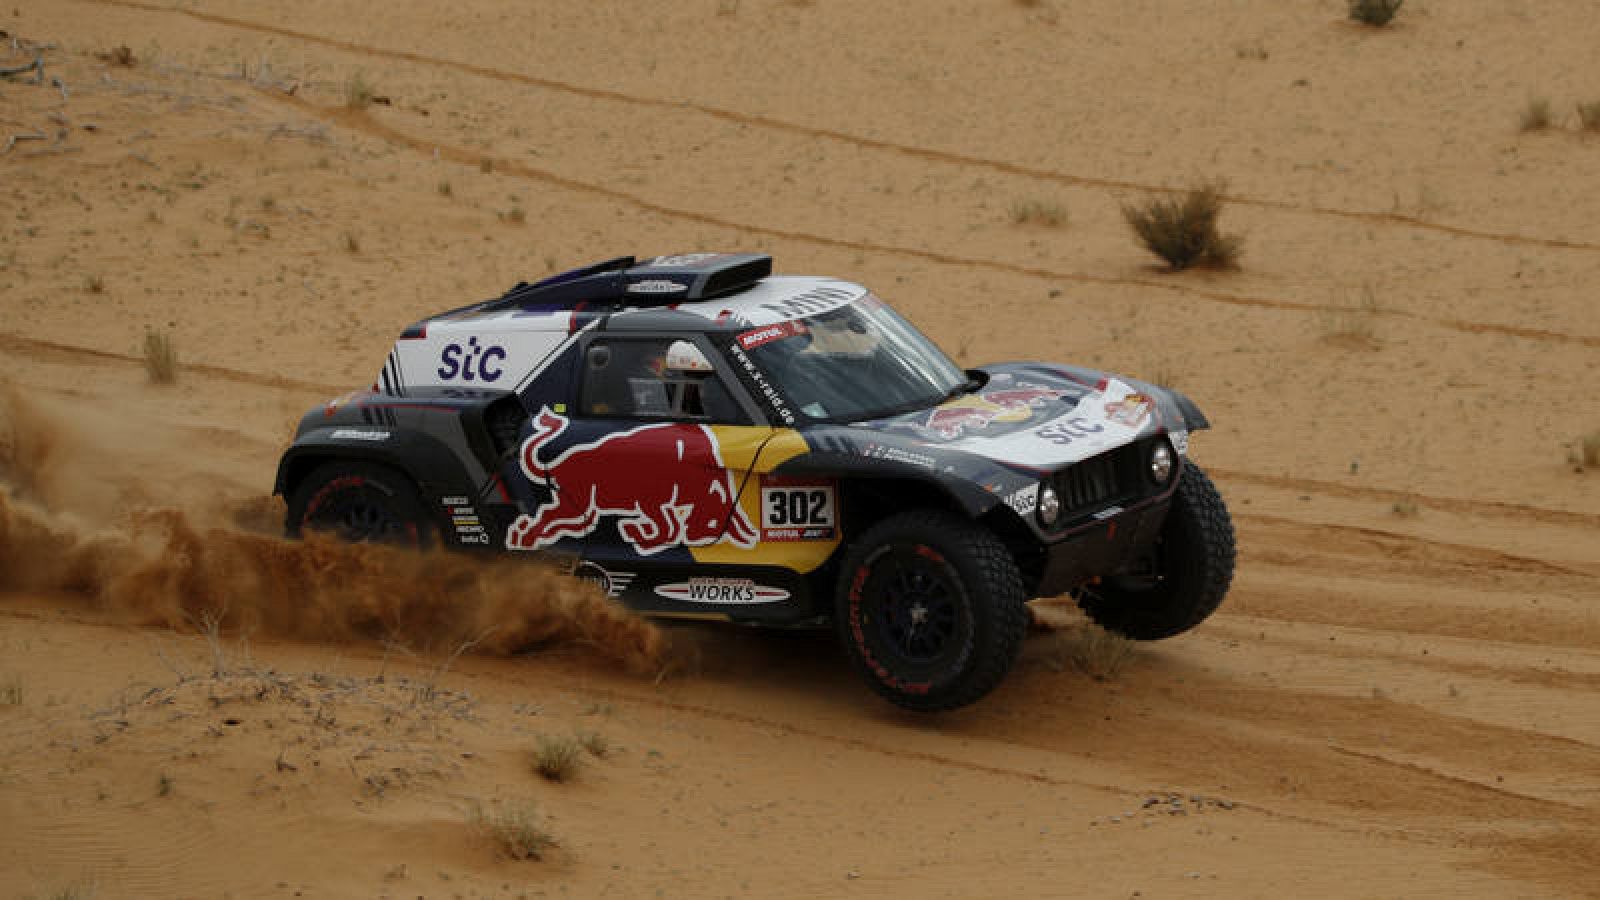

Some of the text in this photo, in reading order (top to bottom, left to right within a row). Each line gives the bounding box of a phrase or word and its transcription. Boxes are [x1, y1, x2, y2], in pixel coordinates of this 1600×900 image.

[743, 327, 783, 345] MOTUL
[768, 490, 828, 525] 302
[689, 584, 754, 601] WORKS
